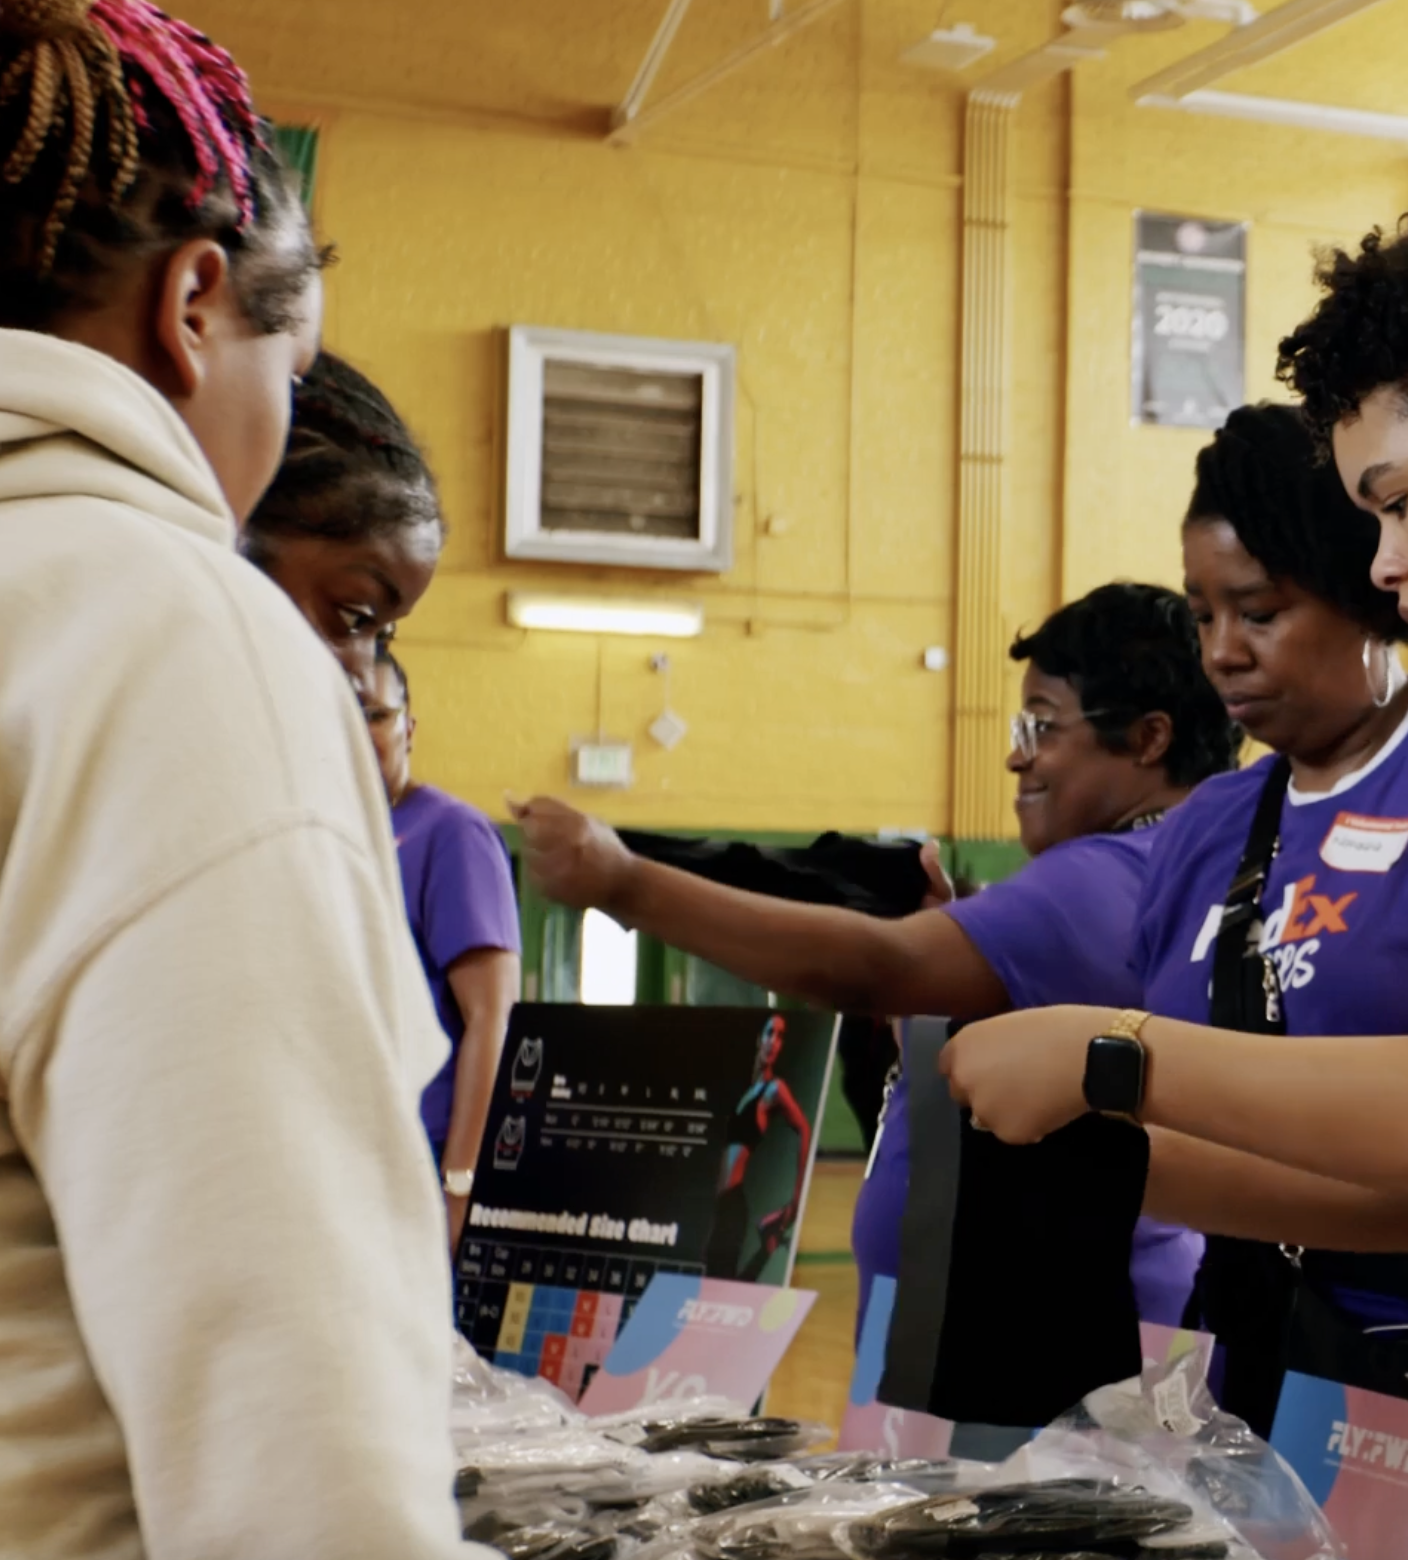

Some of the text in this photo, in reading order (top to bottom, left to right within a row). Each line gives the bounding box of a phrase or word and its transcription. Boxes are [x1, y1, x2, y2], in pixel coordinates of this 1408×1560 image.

[1154, 304, 1229, 342] 2020
[469, 1202, 679, 1247] Recommended Size Chart
